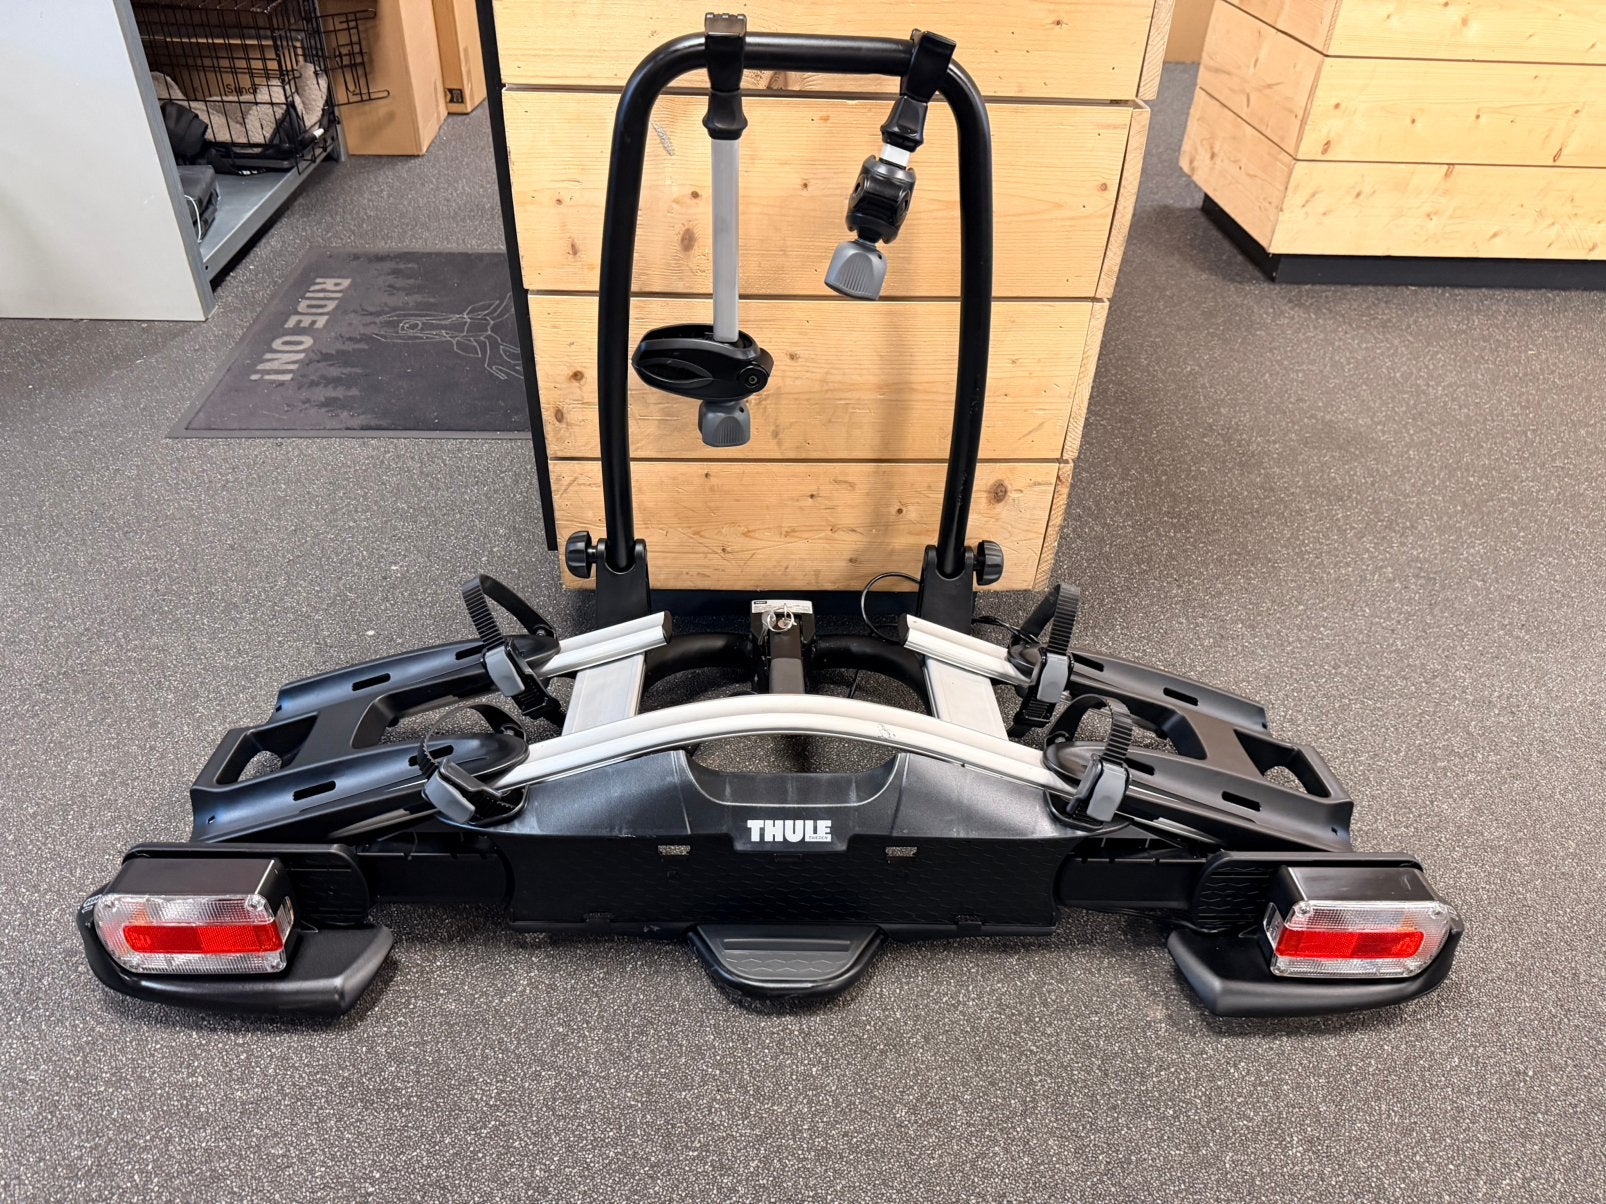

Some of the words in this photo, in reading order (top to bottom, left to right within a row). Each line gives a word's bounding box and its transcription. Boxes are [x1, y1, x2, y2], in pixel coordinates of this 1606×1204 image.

[283, 278, 352, 328] RIDE
[249, 335, 314, 381] ON!
[747, 819, 832, 843] THULE
